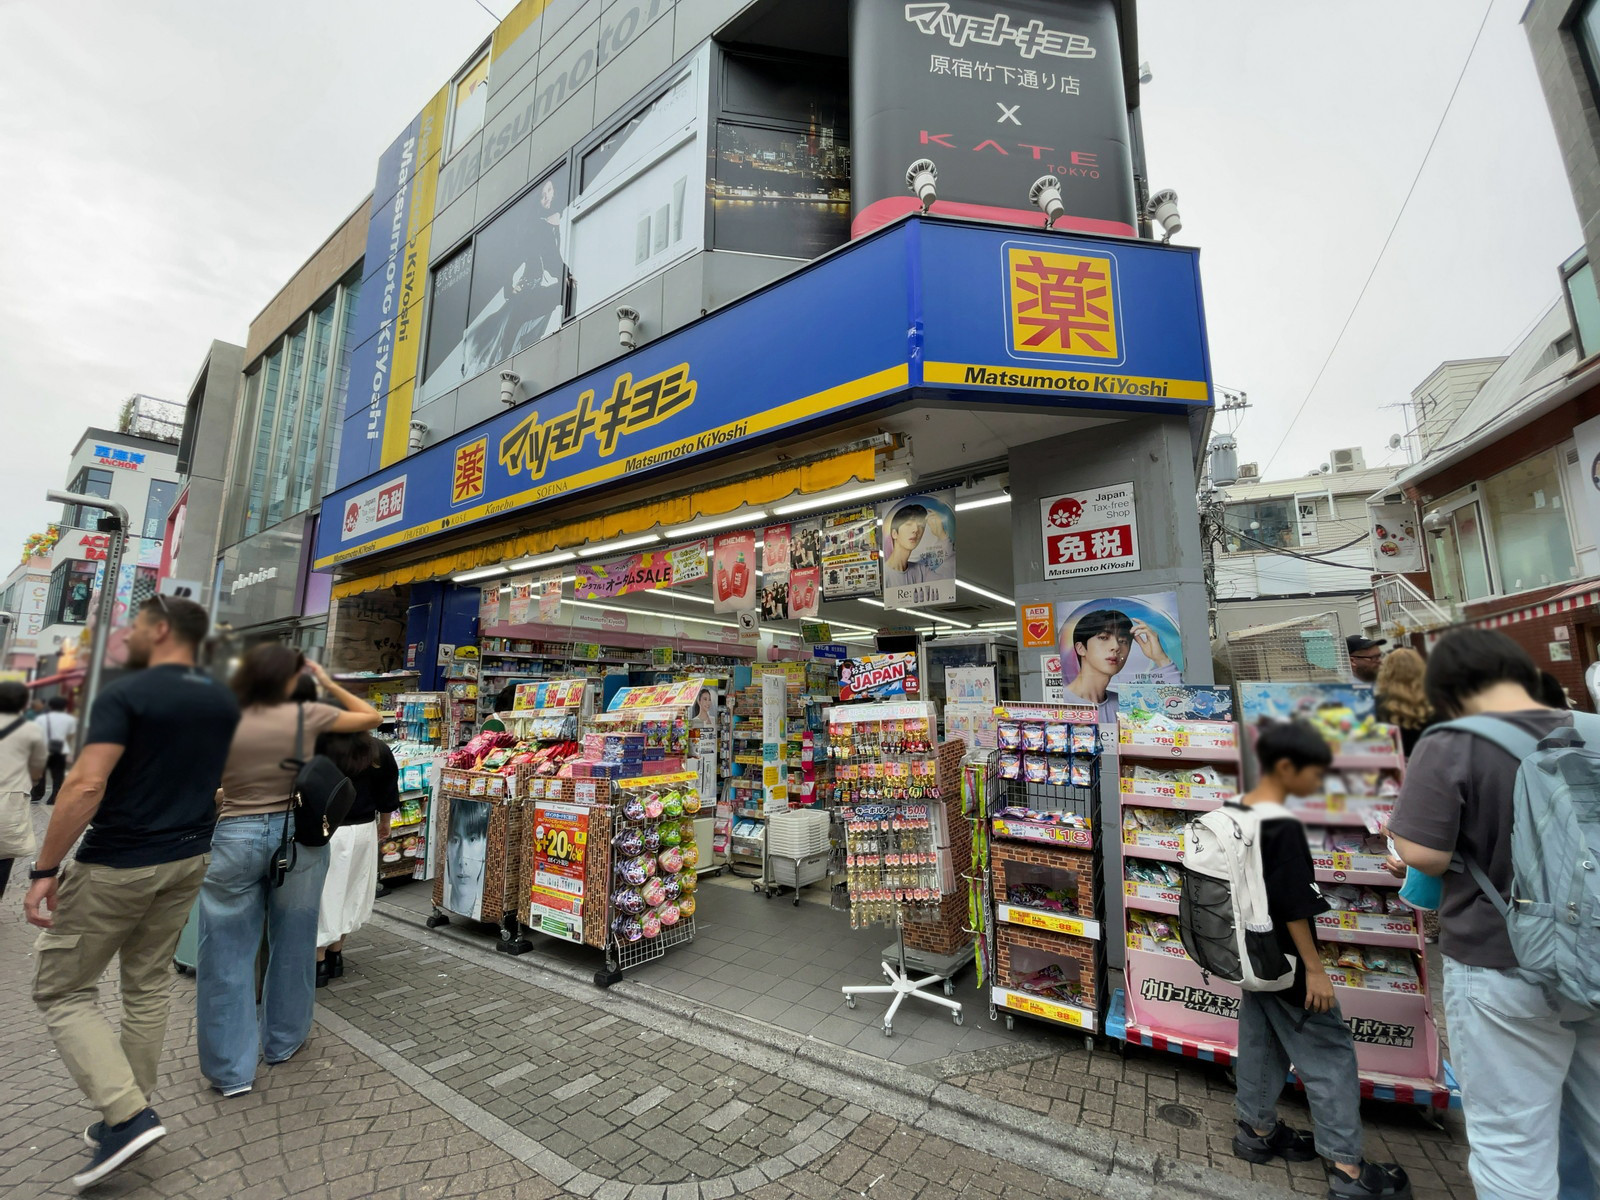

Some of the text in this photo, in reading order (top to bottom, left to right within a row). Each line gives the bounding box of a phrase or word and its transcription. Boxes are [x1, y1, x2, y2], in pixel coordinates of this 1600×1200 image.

[905, 2, 1096, 59] マツモトキヨシ
[929, 54, 1081, 95] 原宿竹下通り店
[440, 6, 640, 207] Matsumoto
[919, 130, 1100, 167] KATE
[1047, 164, 1100, 179] TOKYO
[383, 136, 415, 315] Matsumoto
[1015, 255, 1111, 353] 薬
[964, 367, 1168, 396] Matsumoto KiYoshi
[501, 363, 697, 478] マツモトキヨシ
[624, 420, 749, 473] Matsumoto KiYoshi
[99, 457, 139, 470] ANCHOR
[454, 443, 487, 500] 薬
[536, 481, 568, 499] SOFINA
[377, 487, 403, 518] 免税
[484, 500, 514, 515] Kanebo
[1092, 499, 1130, 513] Tax-free
[1106, 508, 1131, 519] Shop
[1056, 529, 1123, 563] 免税
[1048, 559, 1135, 577] Matsumoto KiYoshi
[579, 614, 607, 624] Matsumoto
[1029, 608, 1046, 616] AED
[852, 663, 905, 691] JAPAN
[1048, 710, 1094, 720] 138
[855, 806, 896, 816] キーホルダー
[906, 805, 927, 815] 500
[1045, 828, 1088, 843] 118
[1160, 840, 1180, 848] 450
[1058, 923, 1072, 931] 88
[1317, 917, 1341, 925] 500
[1386, 923, 1412, 931] 500
[1165, 946, 1186, 955] 500
[1393, 981, 1418, 990] 450
[1057, 1011, 1070, 1019] 88
